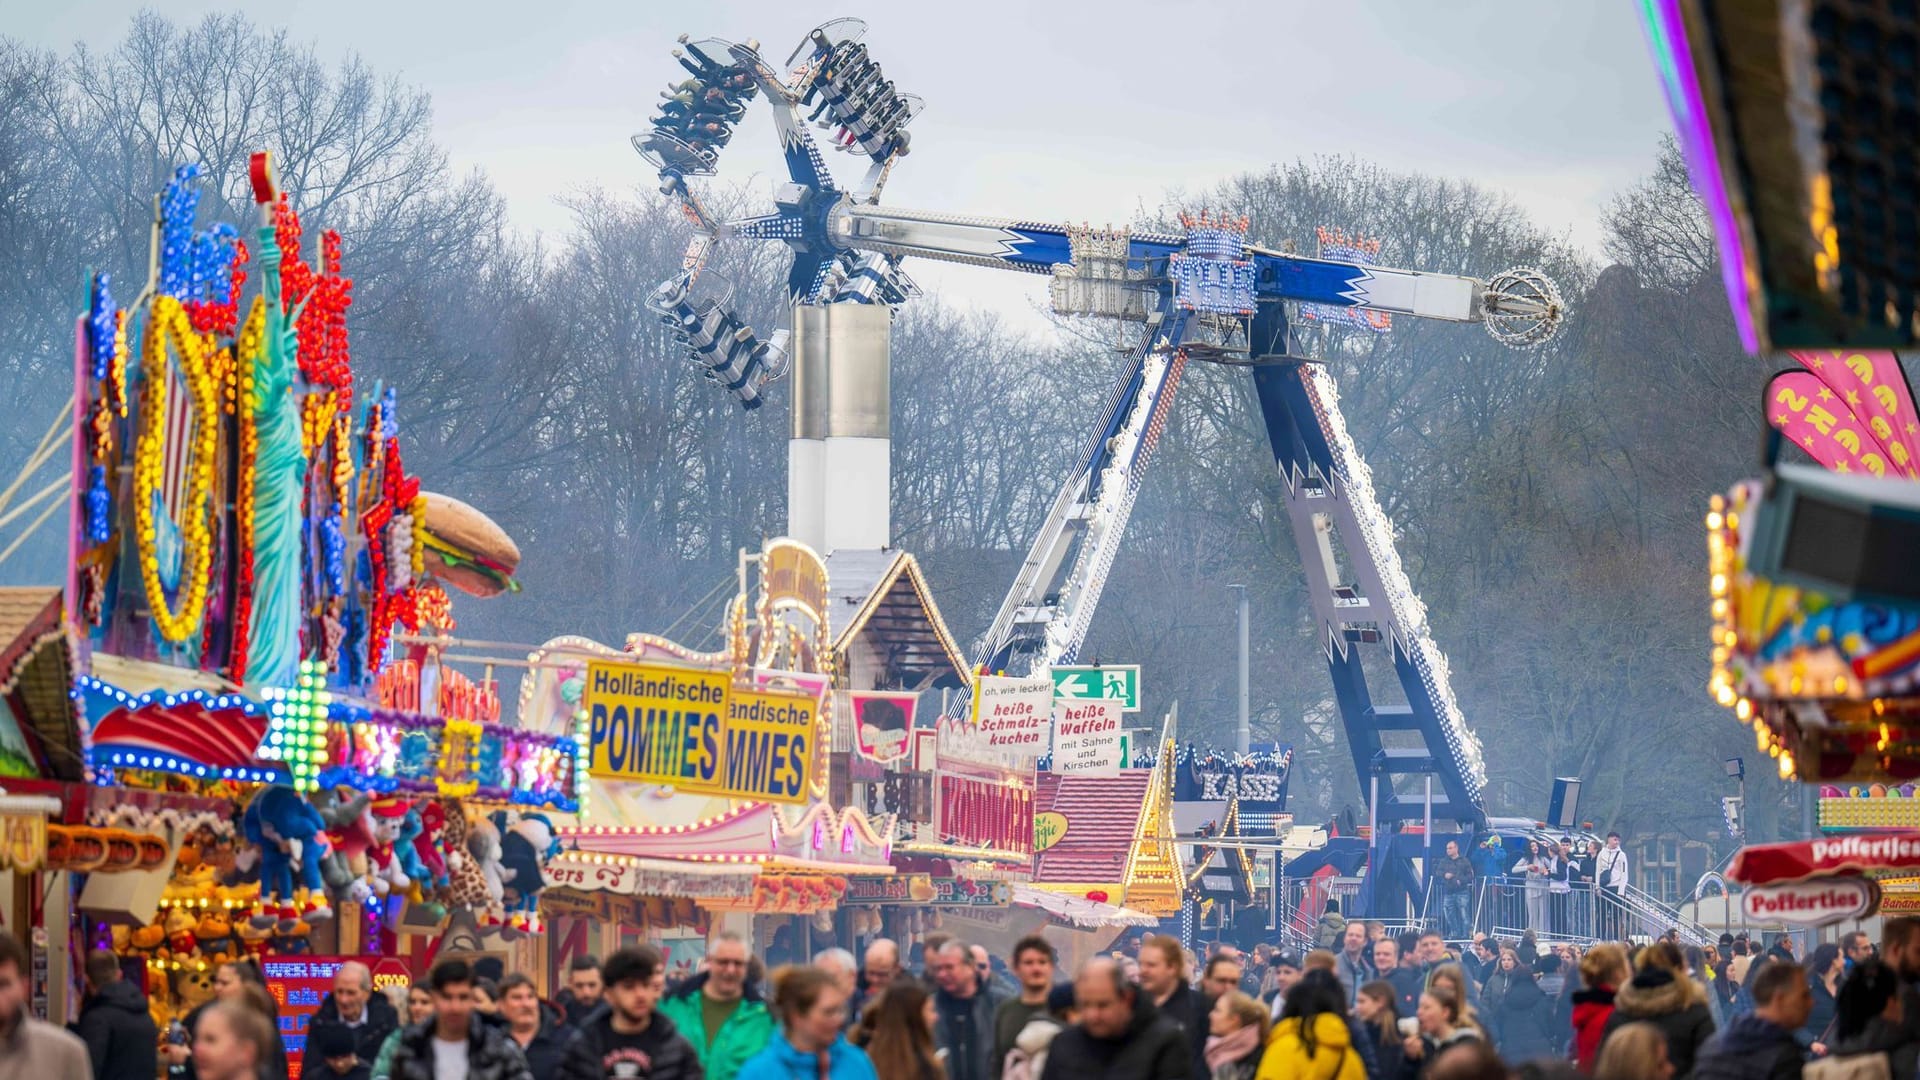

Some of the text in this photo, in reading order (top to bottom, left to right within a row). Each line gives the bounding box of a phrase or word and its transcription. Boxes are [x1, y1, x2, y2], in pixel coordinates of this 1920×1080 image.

[594, 669, 723, 704] Holländische
[1000, 685, 1016, 695] wie
[1019, 682, 1051, 694] lecker!
[994, 702, 1034, 716] heiße
[1065, 704, 1106, 720] heiße
[980, 715, 1049, 732] Schmalz-
[1060, 719, 1116, 736] Waffeln
[590, 703, 720, 780] POMMES
[989, 732, 1040, 746] kuchen
[1061, 736, 1114, 750] mit Sahne
[1077, 749, 1097, 759] und
[1063, 759, 1109, 771] Kirschen
[1200, 773, 1281, 801] KASSE
